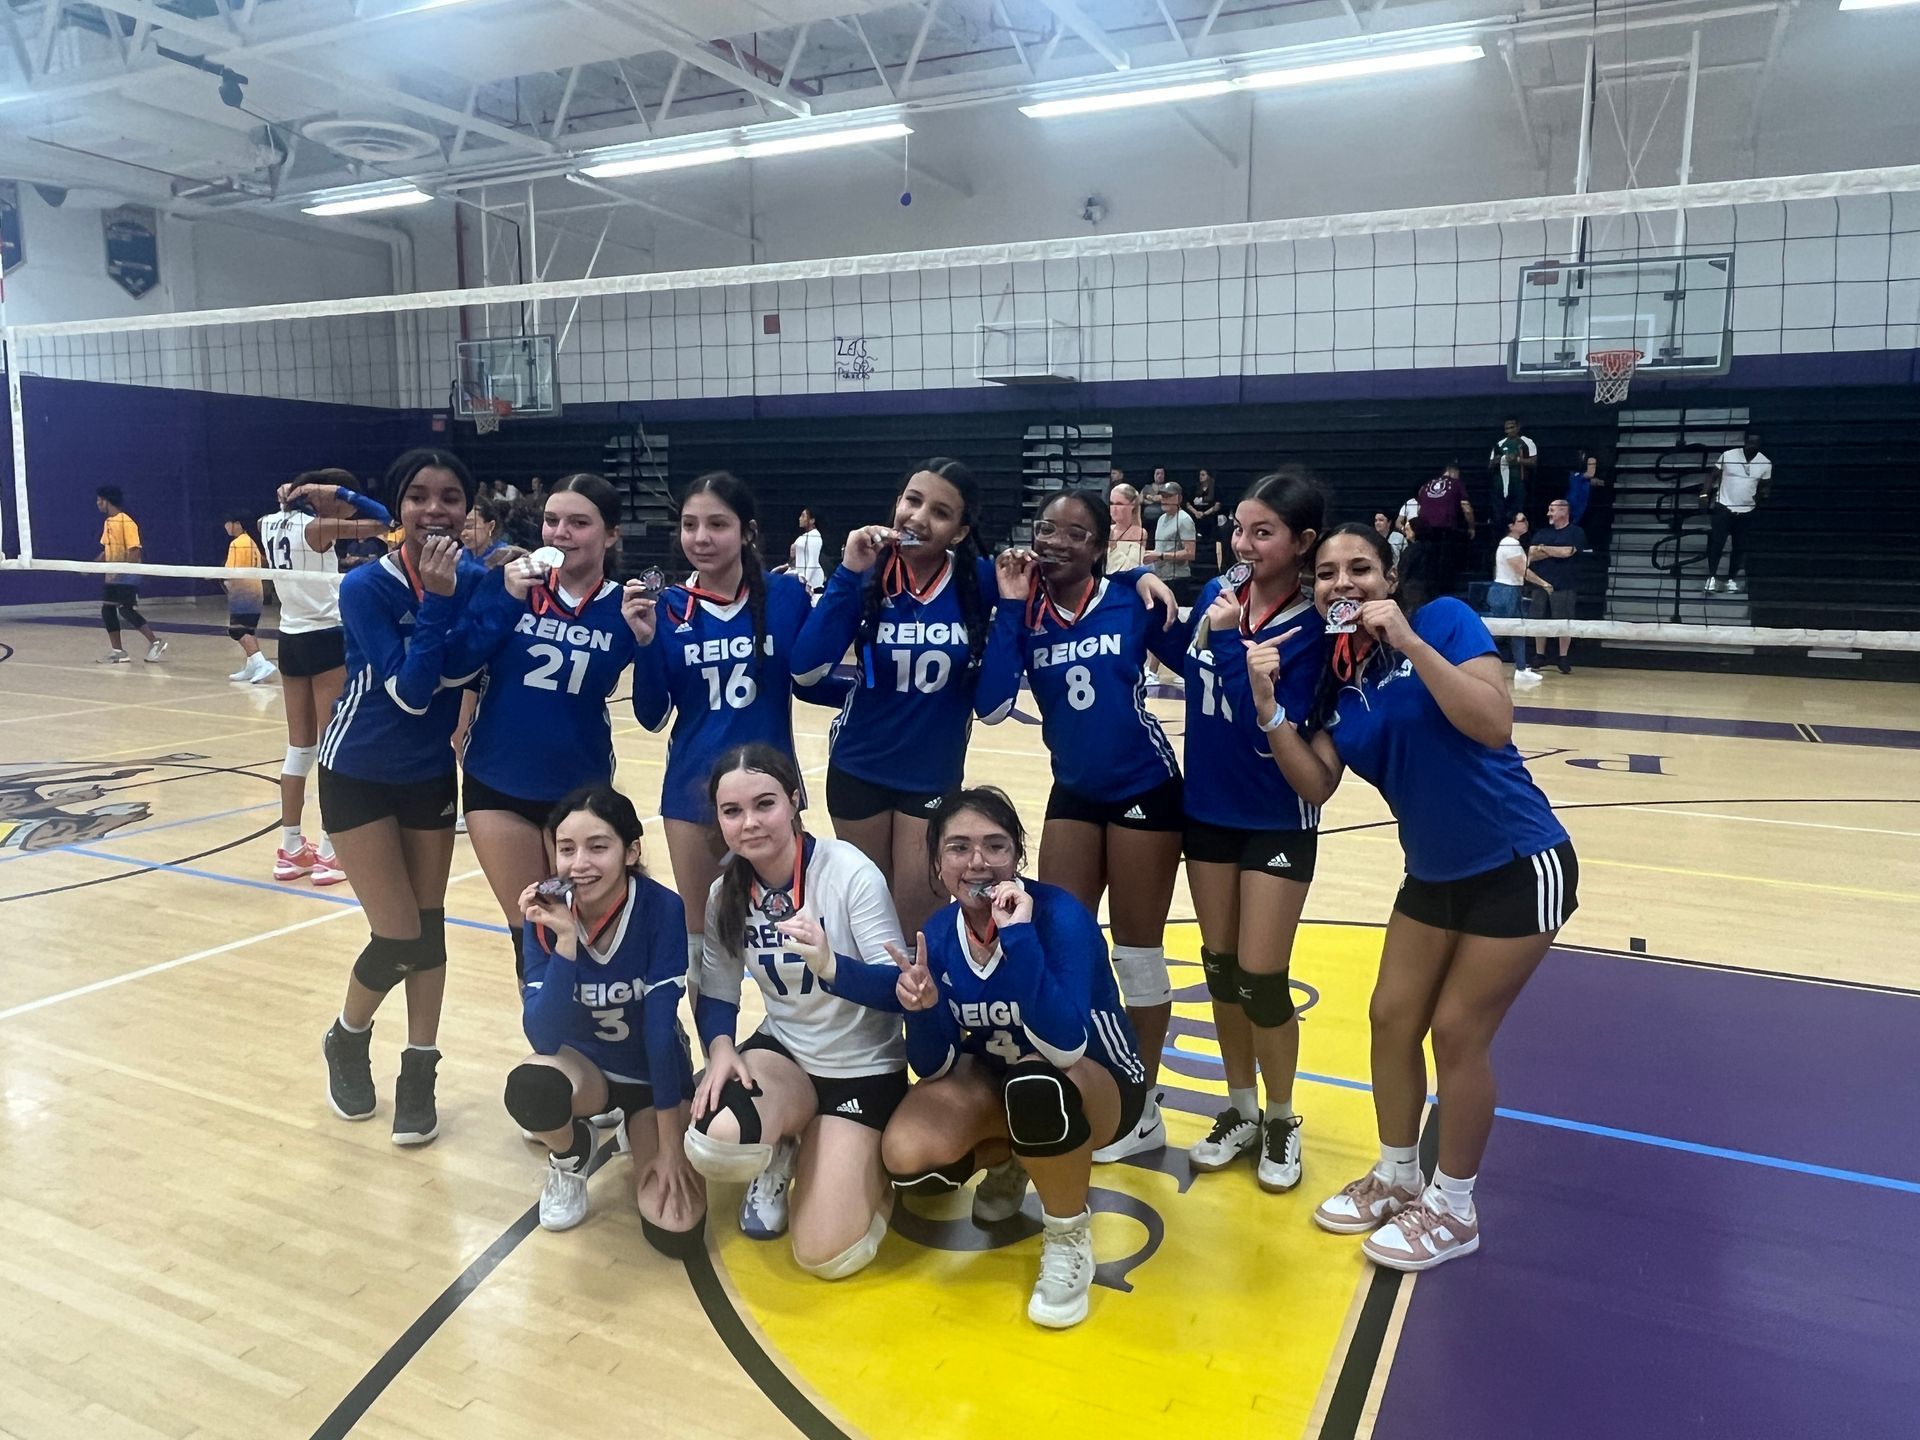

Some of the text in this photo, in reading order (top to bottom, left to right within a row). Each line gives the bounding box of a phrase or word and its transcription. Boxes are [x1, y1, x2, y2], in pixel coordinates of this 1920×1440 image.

[267, 536, 293, 570] 13
[514, 613, 613, 652] REIGN
[876, 622, 969, 645] REIGN
[1033, 633, 1122, 670] REIGN
[523, 643, 591, 695] 21
[701, 662, 757, 710] 16
[891, 649, 952, 693] 10
[1065, 665, 1096, 711] 8
[758, 953, 814, 996] 17
[591, 1007, 630, 1042] 3
[985, 1030, 1021, 1065] 4
